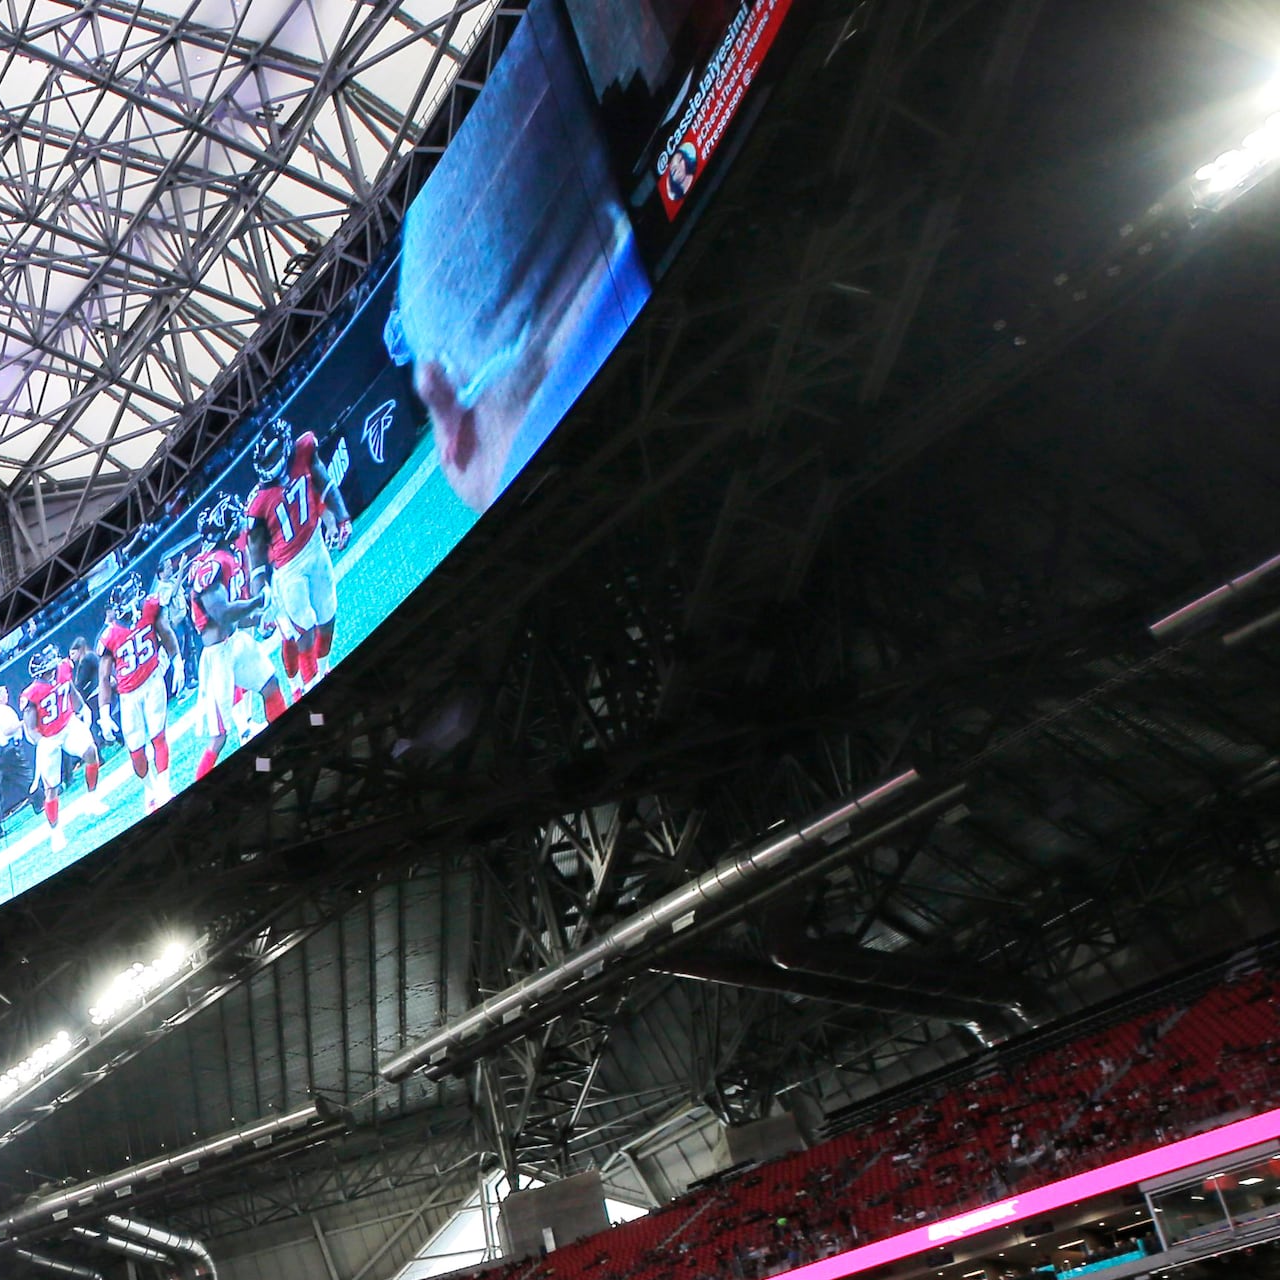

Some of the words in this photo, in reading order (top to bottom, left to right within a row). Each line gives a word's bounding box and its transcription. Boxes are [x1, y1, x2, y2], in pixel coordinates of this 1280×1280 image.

[657, 4, 748, 175] @CassieJaiyesimi
[691, 87, 715, 133] HAPPY
[716, 50, 737, 89] GAME
[697, 12, 769, 146] #CheckTheLastName
[702, 86, 743, 160] #Preseason
[274, 475, 310, 543] 17
[116, 625, 156, 676] 35
[41, 682, 71, 725] 37
